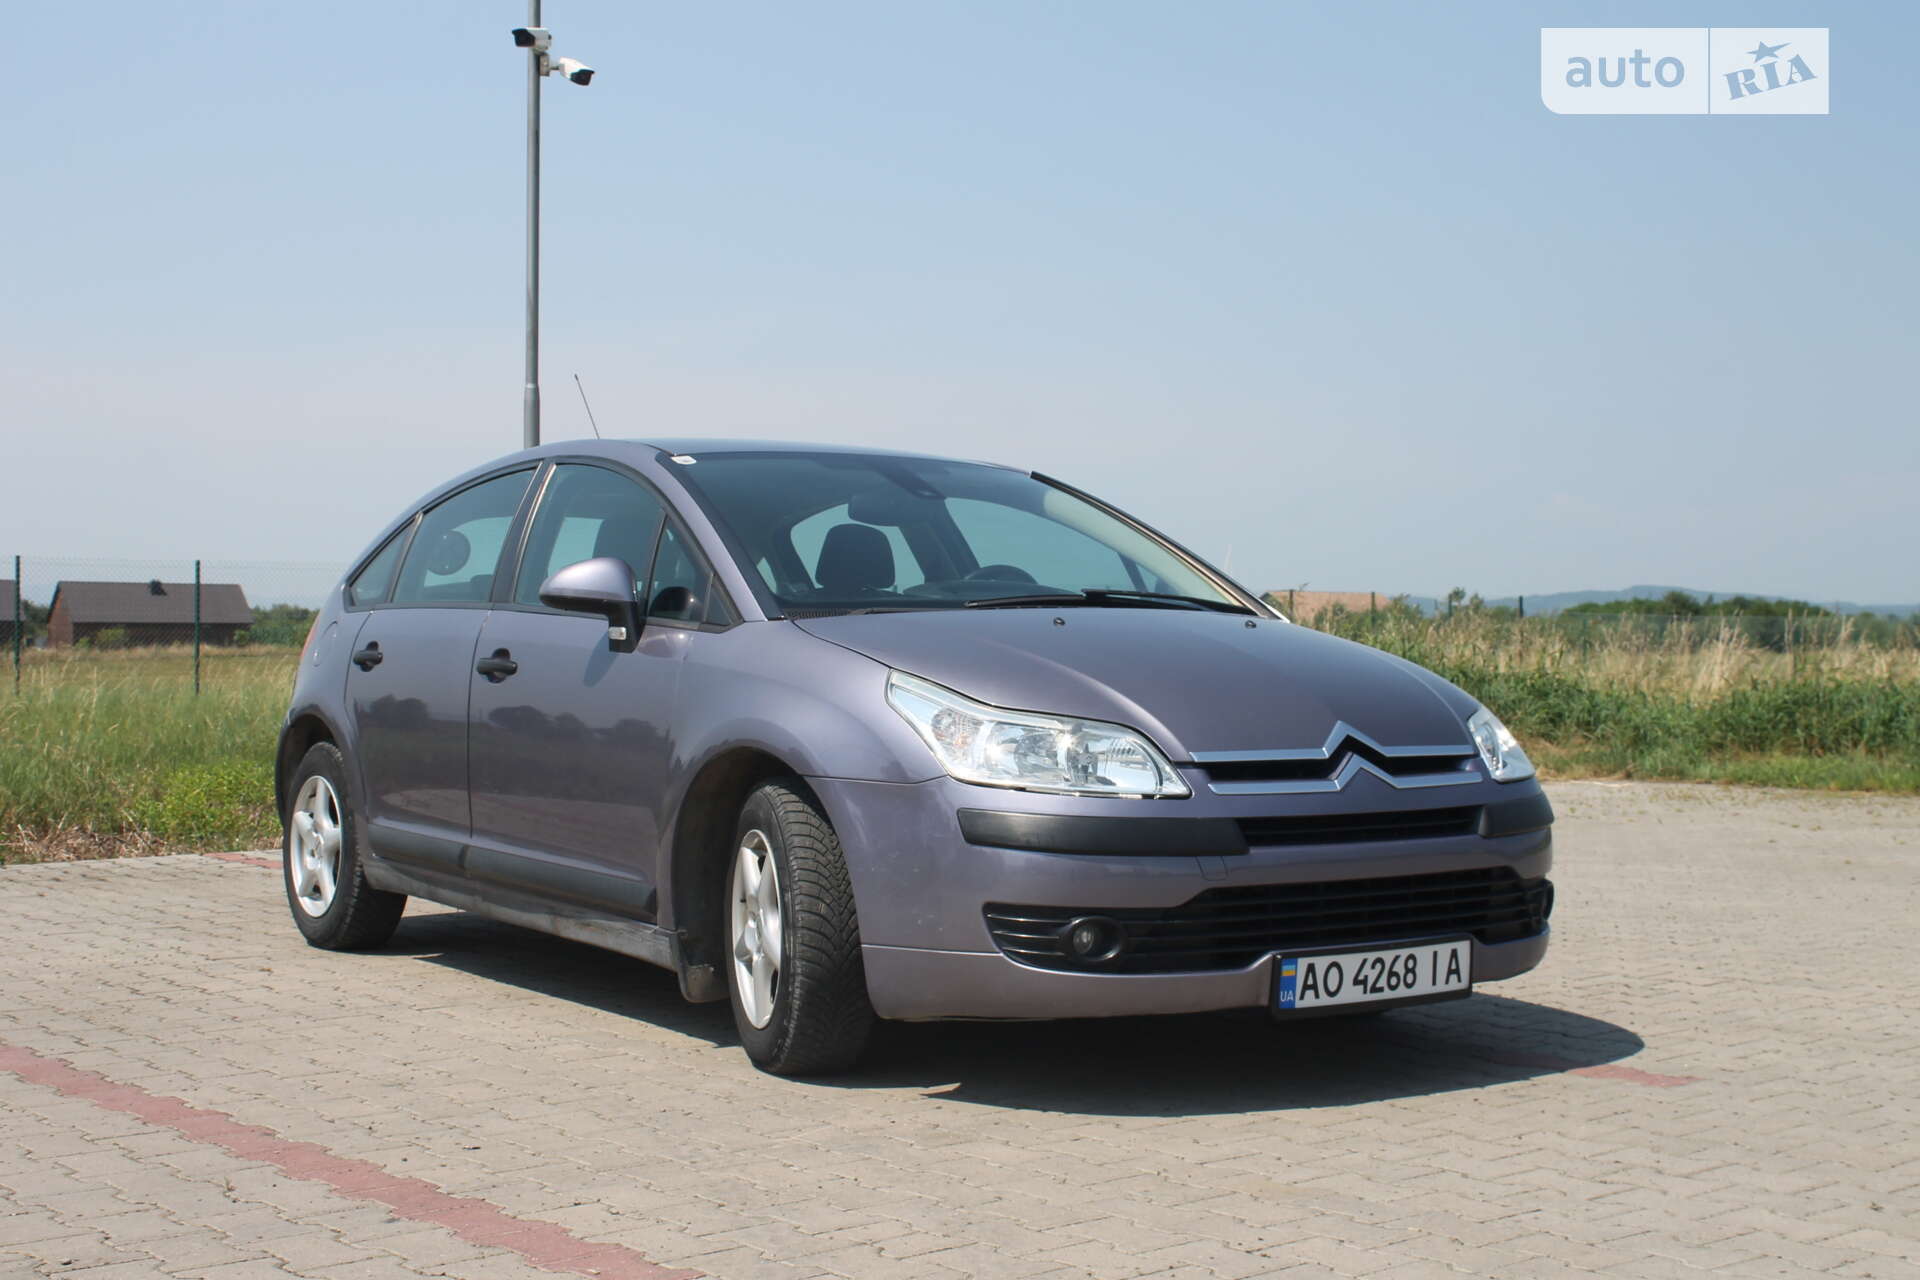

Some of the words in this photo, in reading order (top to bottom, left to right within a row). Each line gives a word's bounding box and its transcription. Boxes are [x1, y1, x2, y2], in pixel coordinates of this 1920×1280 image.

[1299, 961, 1344, 1001] AO
[1352, 953, 1417, 995] 4268
[1431, 948, 1462, 987] IA
[1280, 991, 1294, 1002] UA
